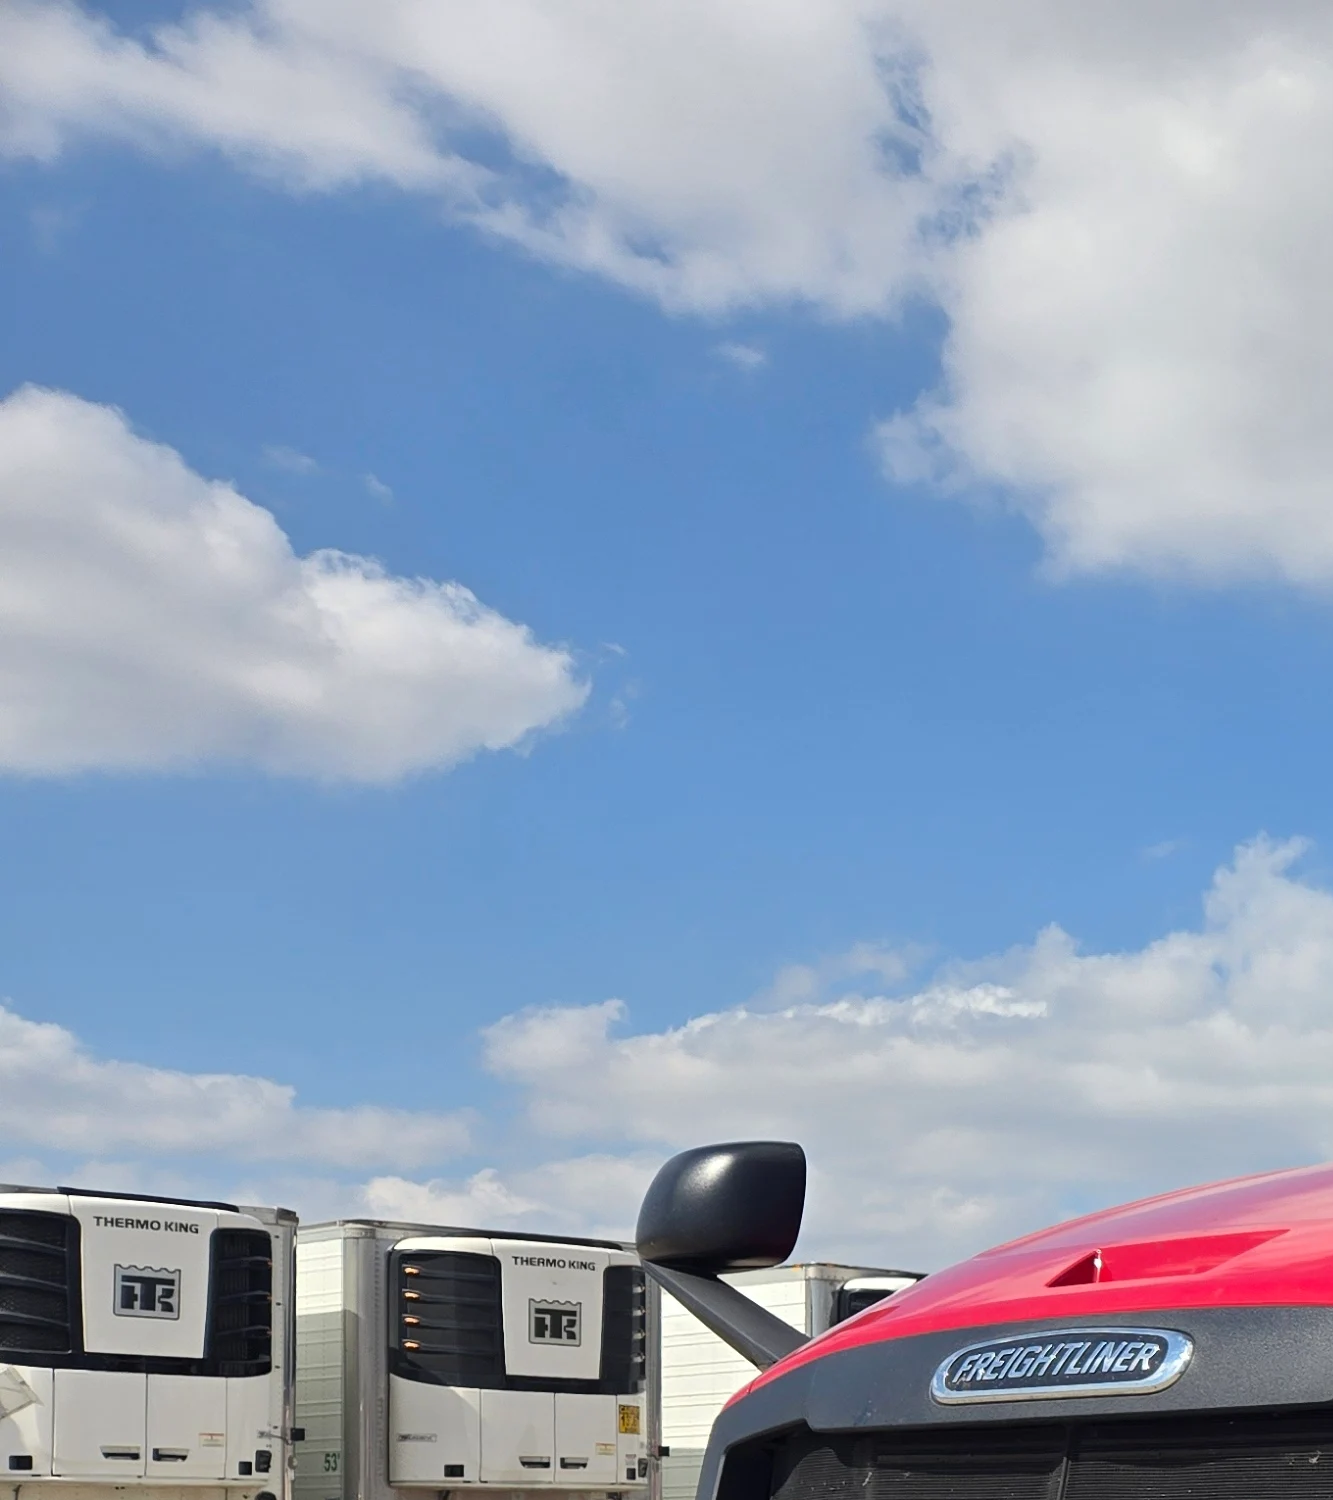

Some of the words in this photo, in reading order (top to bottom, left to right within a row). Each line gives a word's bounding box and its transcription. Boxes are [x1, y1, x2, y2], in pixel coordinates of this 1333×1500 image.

[92, 1215, 161, 1231] THERMO
[164, 1220, 200, 1234] KING
[511, 1255, 566, 1269] THERMO
[568, 1260, 596, 1272] KING
[951, 1341, 1162, 1384] FREIGHTLINER
